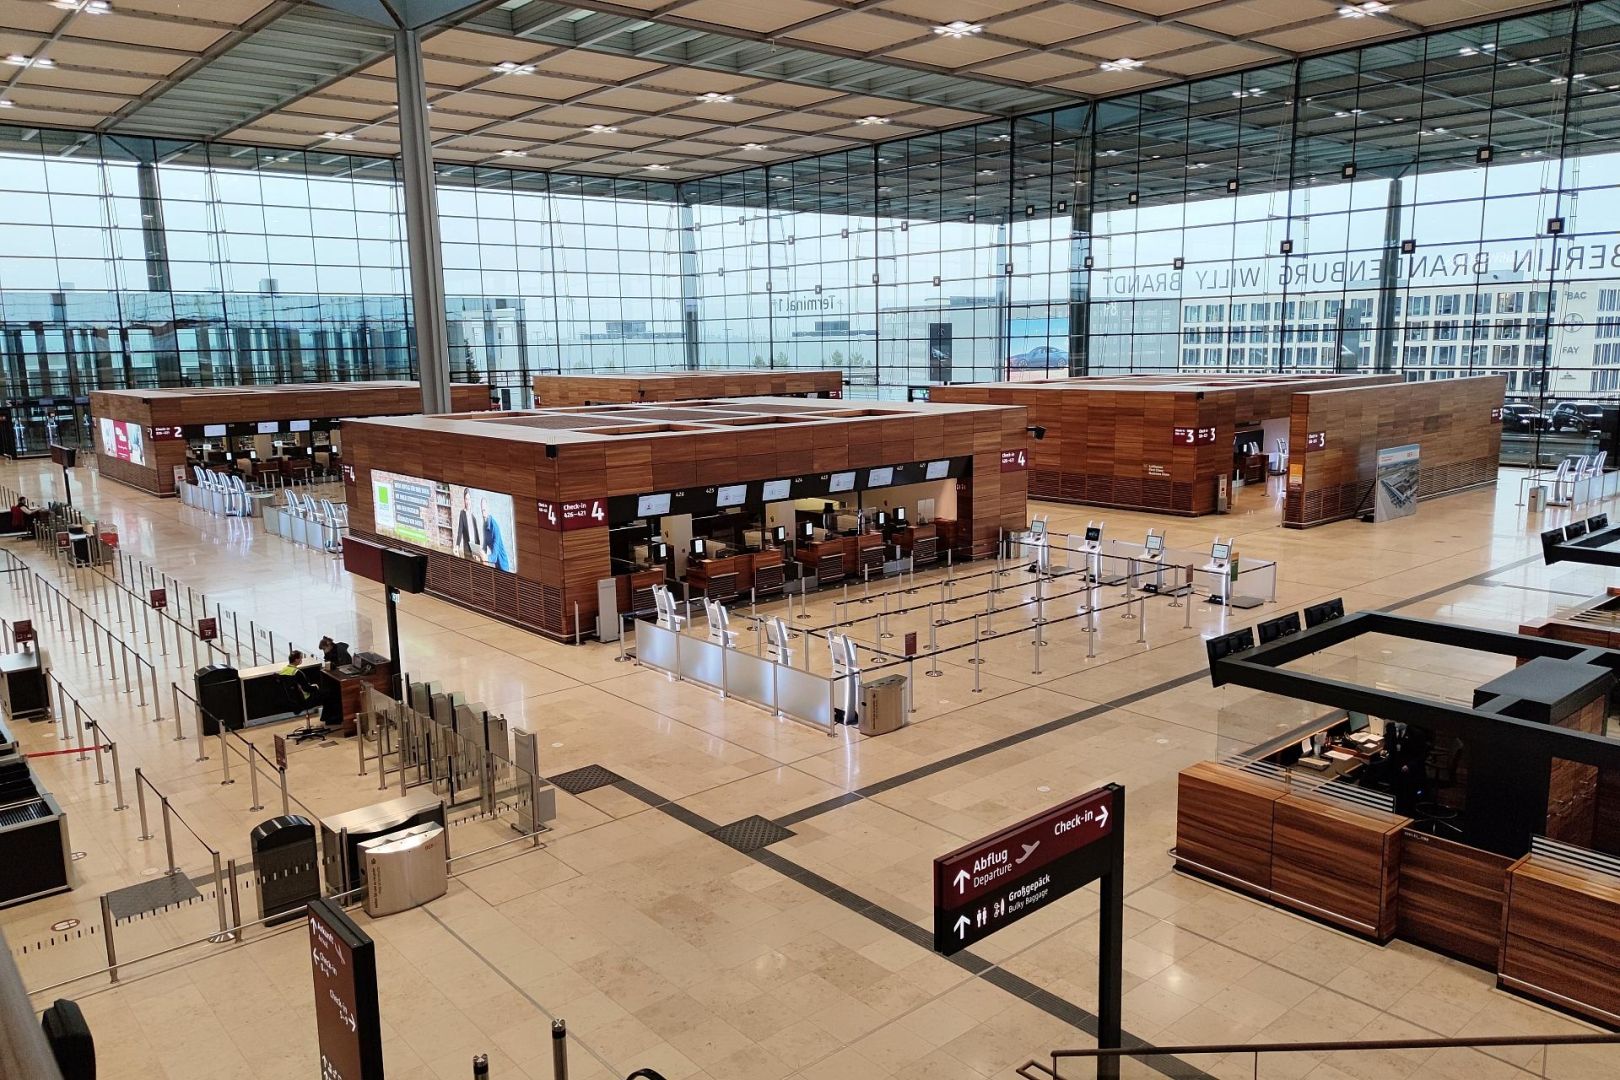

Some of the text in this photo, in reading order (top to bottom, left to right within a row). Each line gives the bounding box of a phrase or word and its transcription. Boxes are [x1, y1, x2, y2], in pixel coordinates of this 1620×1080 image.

[174, 426, 183, 438] 2
[1186, 429, 1194, 443] 3
[1210, 427, 1216, 441] 3
[1319, 432, 1325, 447] 3
[1017, 451, 1026, 467] 4
[547, 504, 557, 525] 4
[563, 502, 587, 511] Check-in
[591, 500, 605, 521] 4
[1054, 810, 1094, 836] Check-in
[973, 849, 1008, 874] Abflug
[973, 863, 1013, 888] Departure
[1008, 874, 1051, 902] Großgepäck
[1008, 888, 1049, 914] Bulky Baggage
